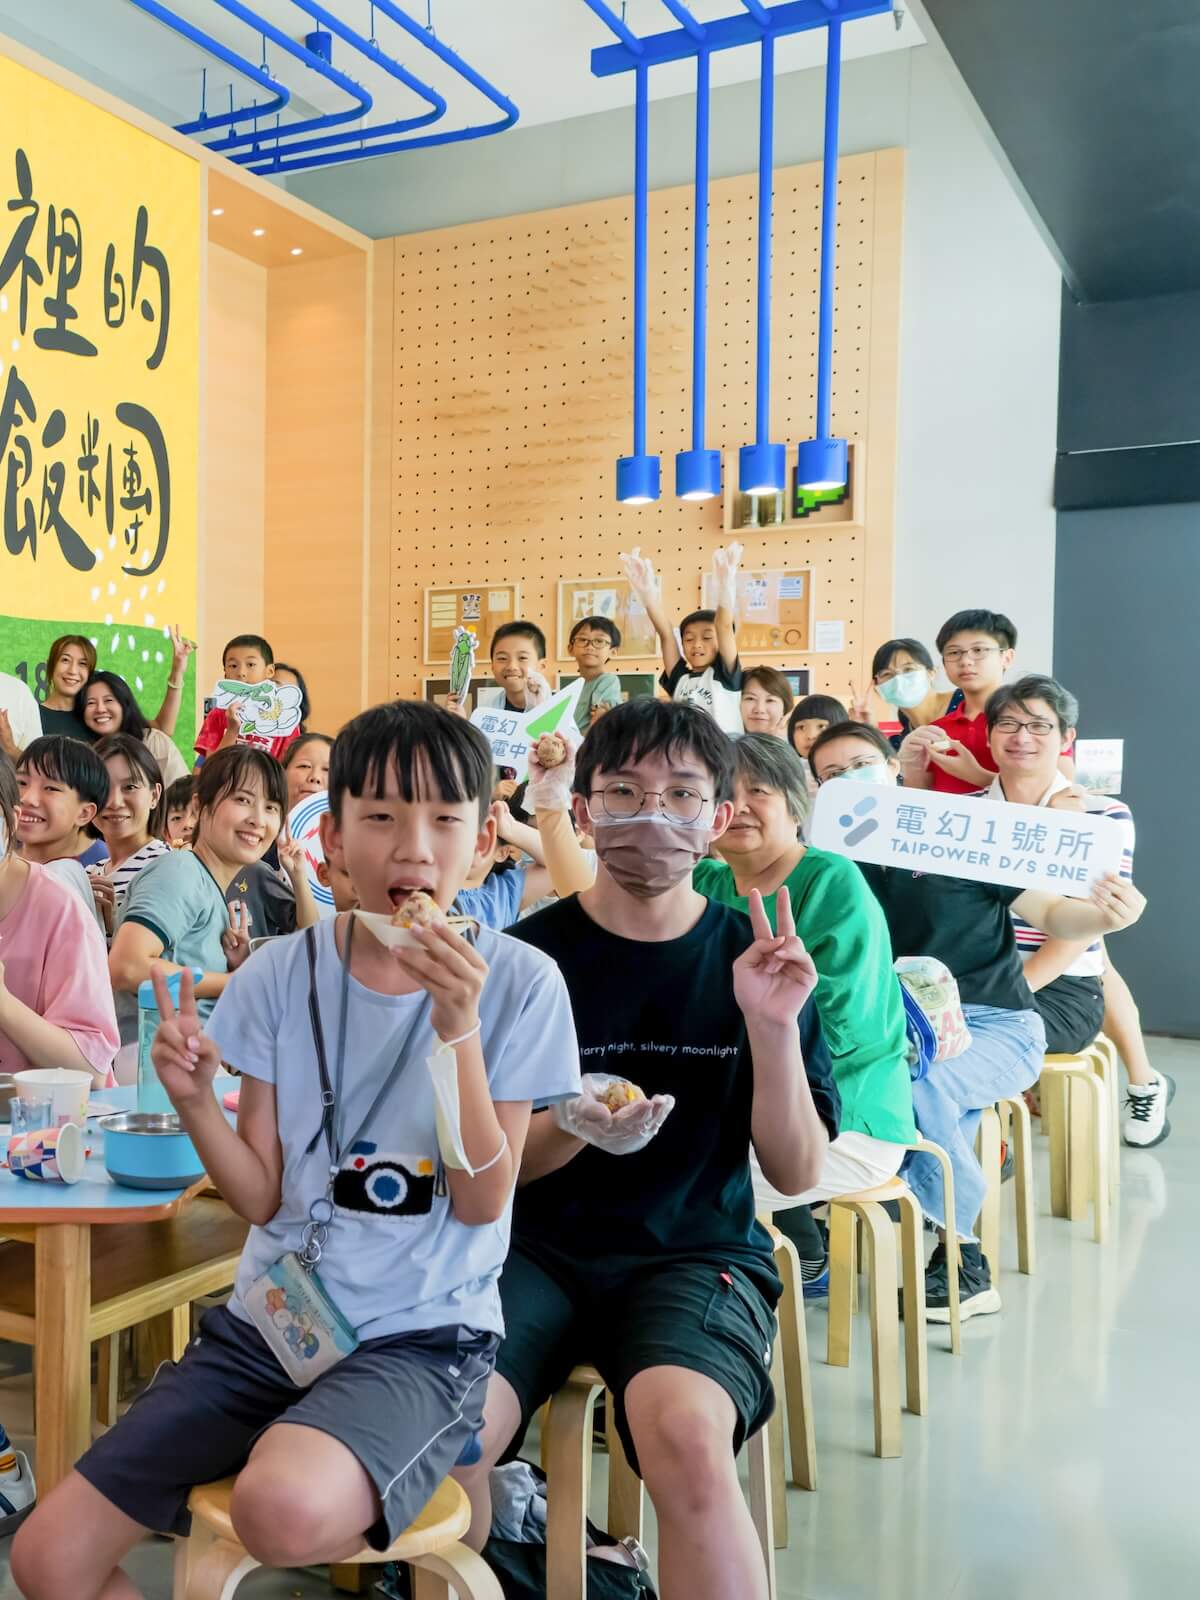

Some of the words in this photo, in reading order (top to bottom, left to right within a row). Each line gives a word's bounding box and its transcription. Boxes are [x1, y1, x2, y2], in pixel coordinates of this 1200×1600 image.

[481, 715, 518, 736] 電幻
[492, 739, 527, 759] 電中
[896, 803, 1094, 862] 電幻1號所
[890, 838, 991, 867] TAIPOWER
[999, 855, 1038, 874] D/S
[1046, 863, 1089, 882] ONE
[640, 1040, 678, 1056] silvery
[681, 1044, 739, 1059] moonlight
